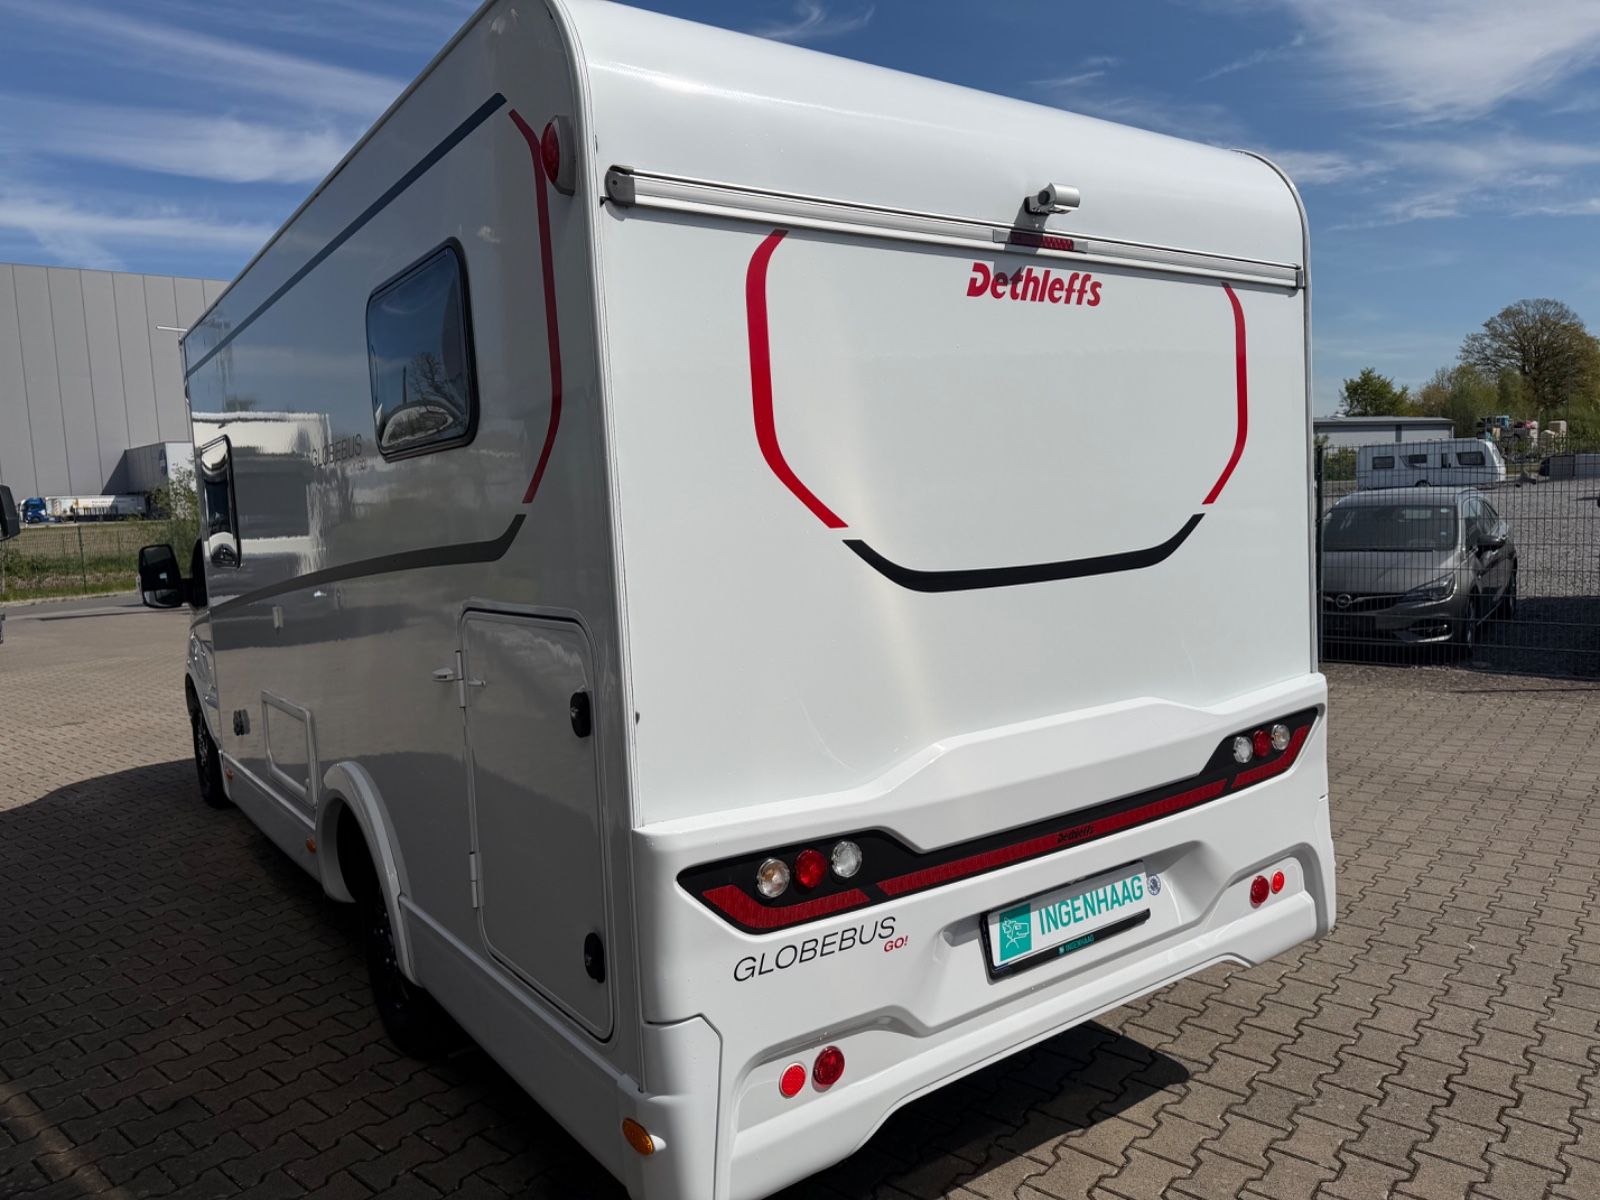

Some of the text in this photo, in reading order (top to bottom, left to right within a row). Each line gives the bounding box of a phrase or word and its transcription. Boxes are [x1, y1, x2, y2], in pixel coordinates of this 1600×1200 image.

[967, 262, 1103, 307] Dethleffs
[1038, 875, 1144, 935] INGENHAAG
[733, 916, 897, 982] GLOBEBUS
[883, 935, 908, 953] GO!
